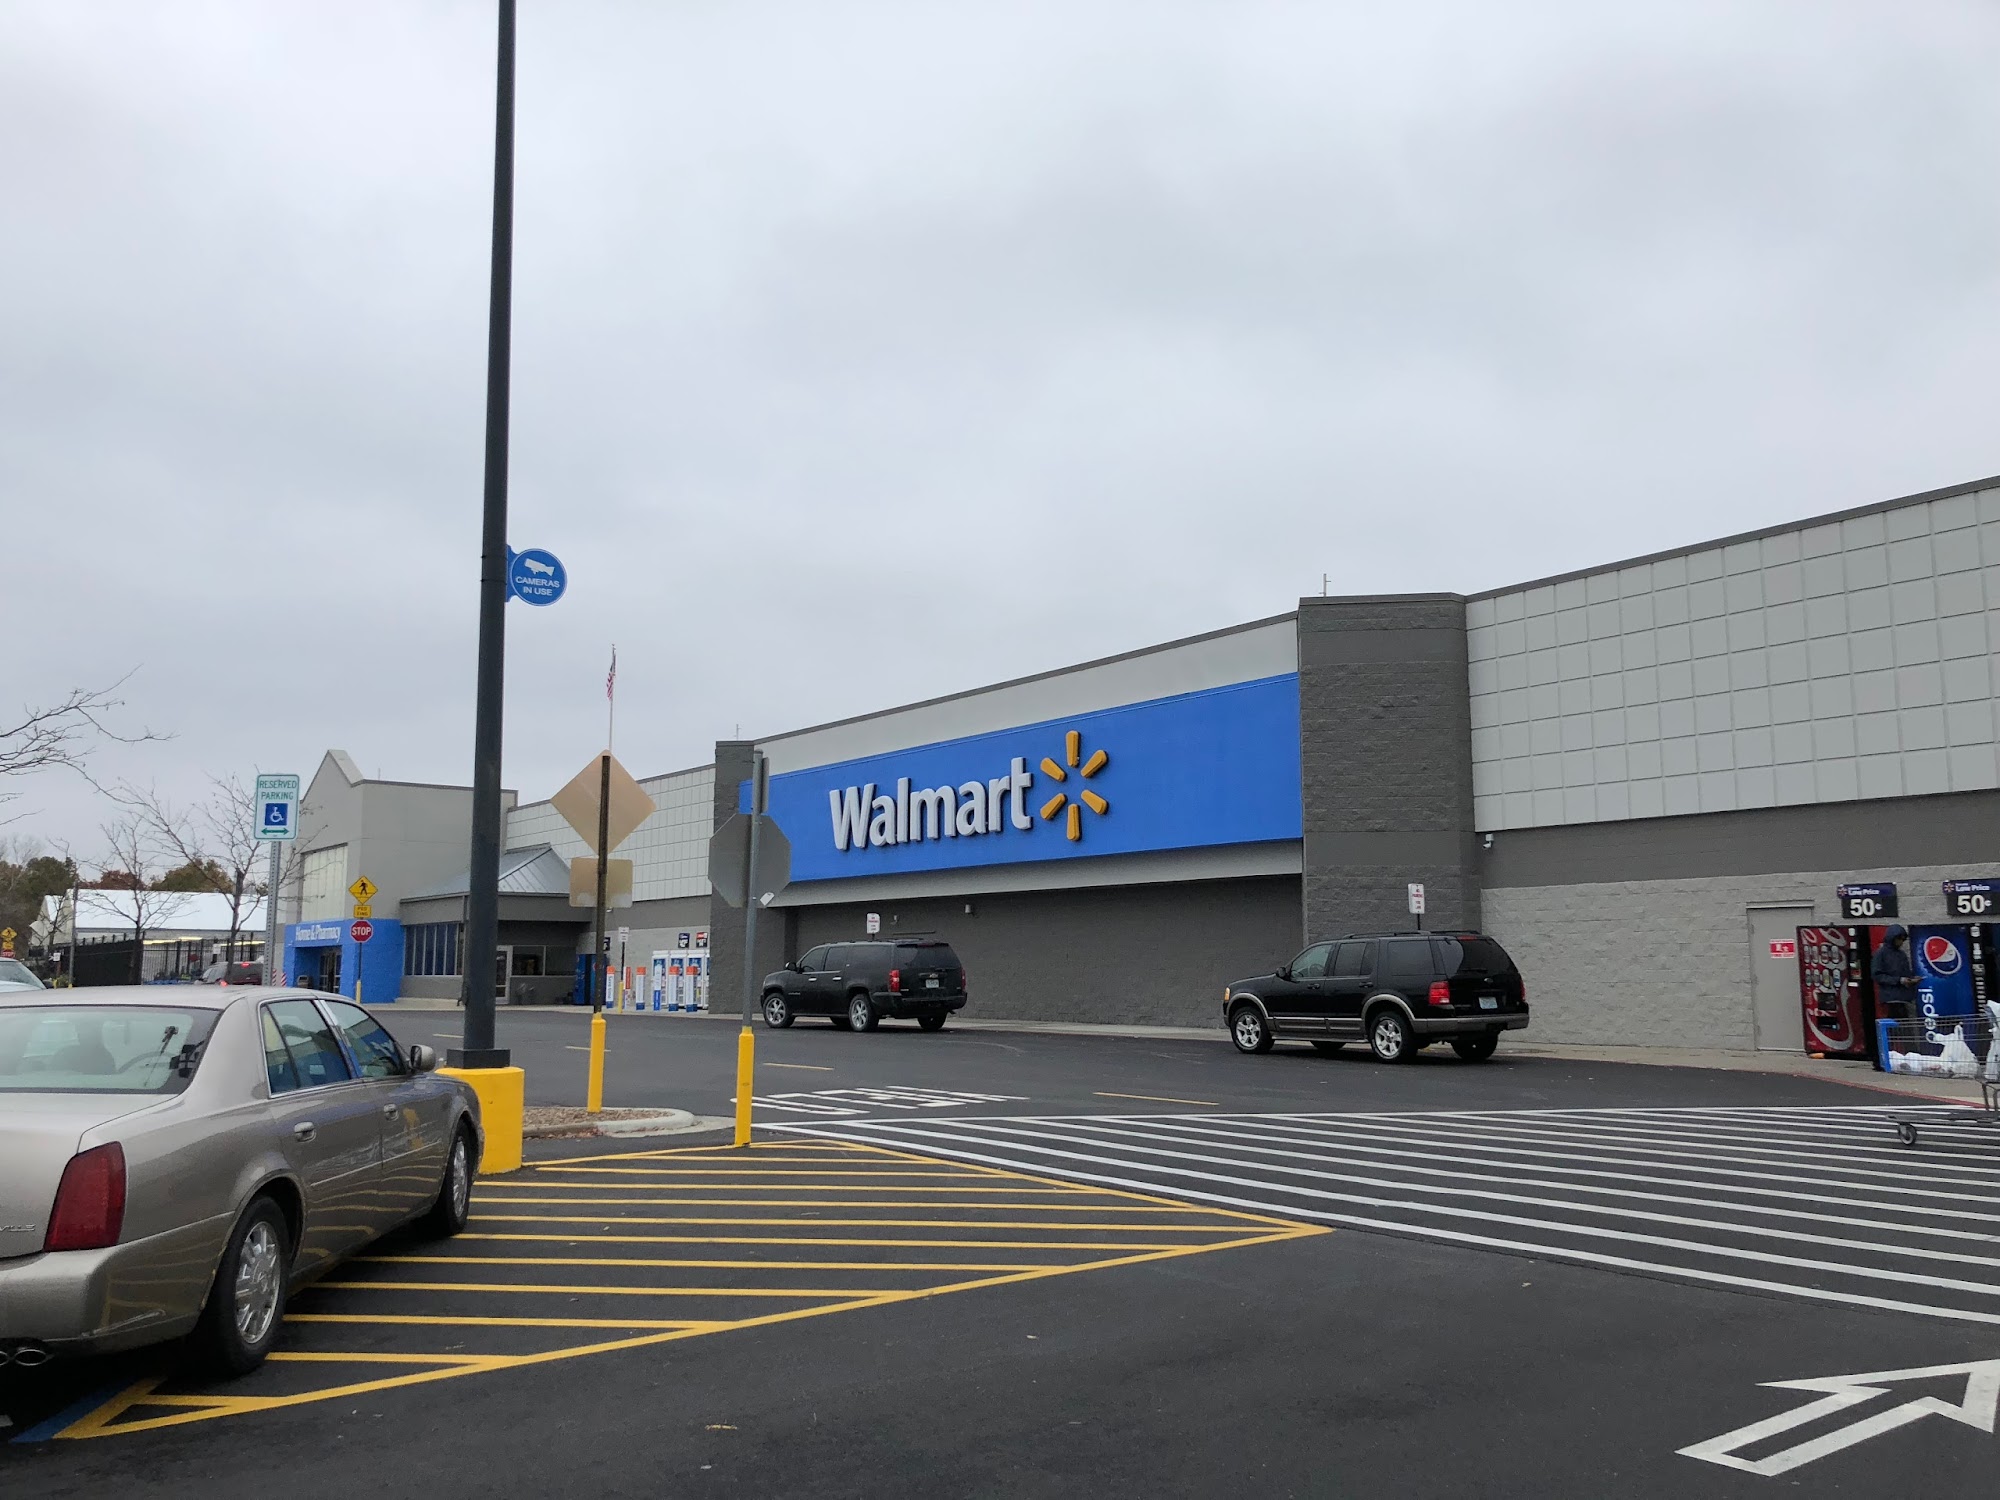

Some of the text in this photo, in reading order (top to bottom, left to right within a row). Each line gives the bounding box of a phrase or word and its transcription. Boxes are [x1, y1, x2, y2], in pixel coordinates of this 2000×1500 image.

[515, 576, 560, 588] CAMERAS
[534, 587, 553, 596] USE
[260, 780, 297, 789] RESERVED
[261, 791, 294, 800] PARKING
[829, 757, 1033, 850] Walmart
[351, 926, 372, 936] STOP
